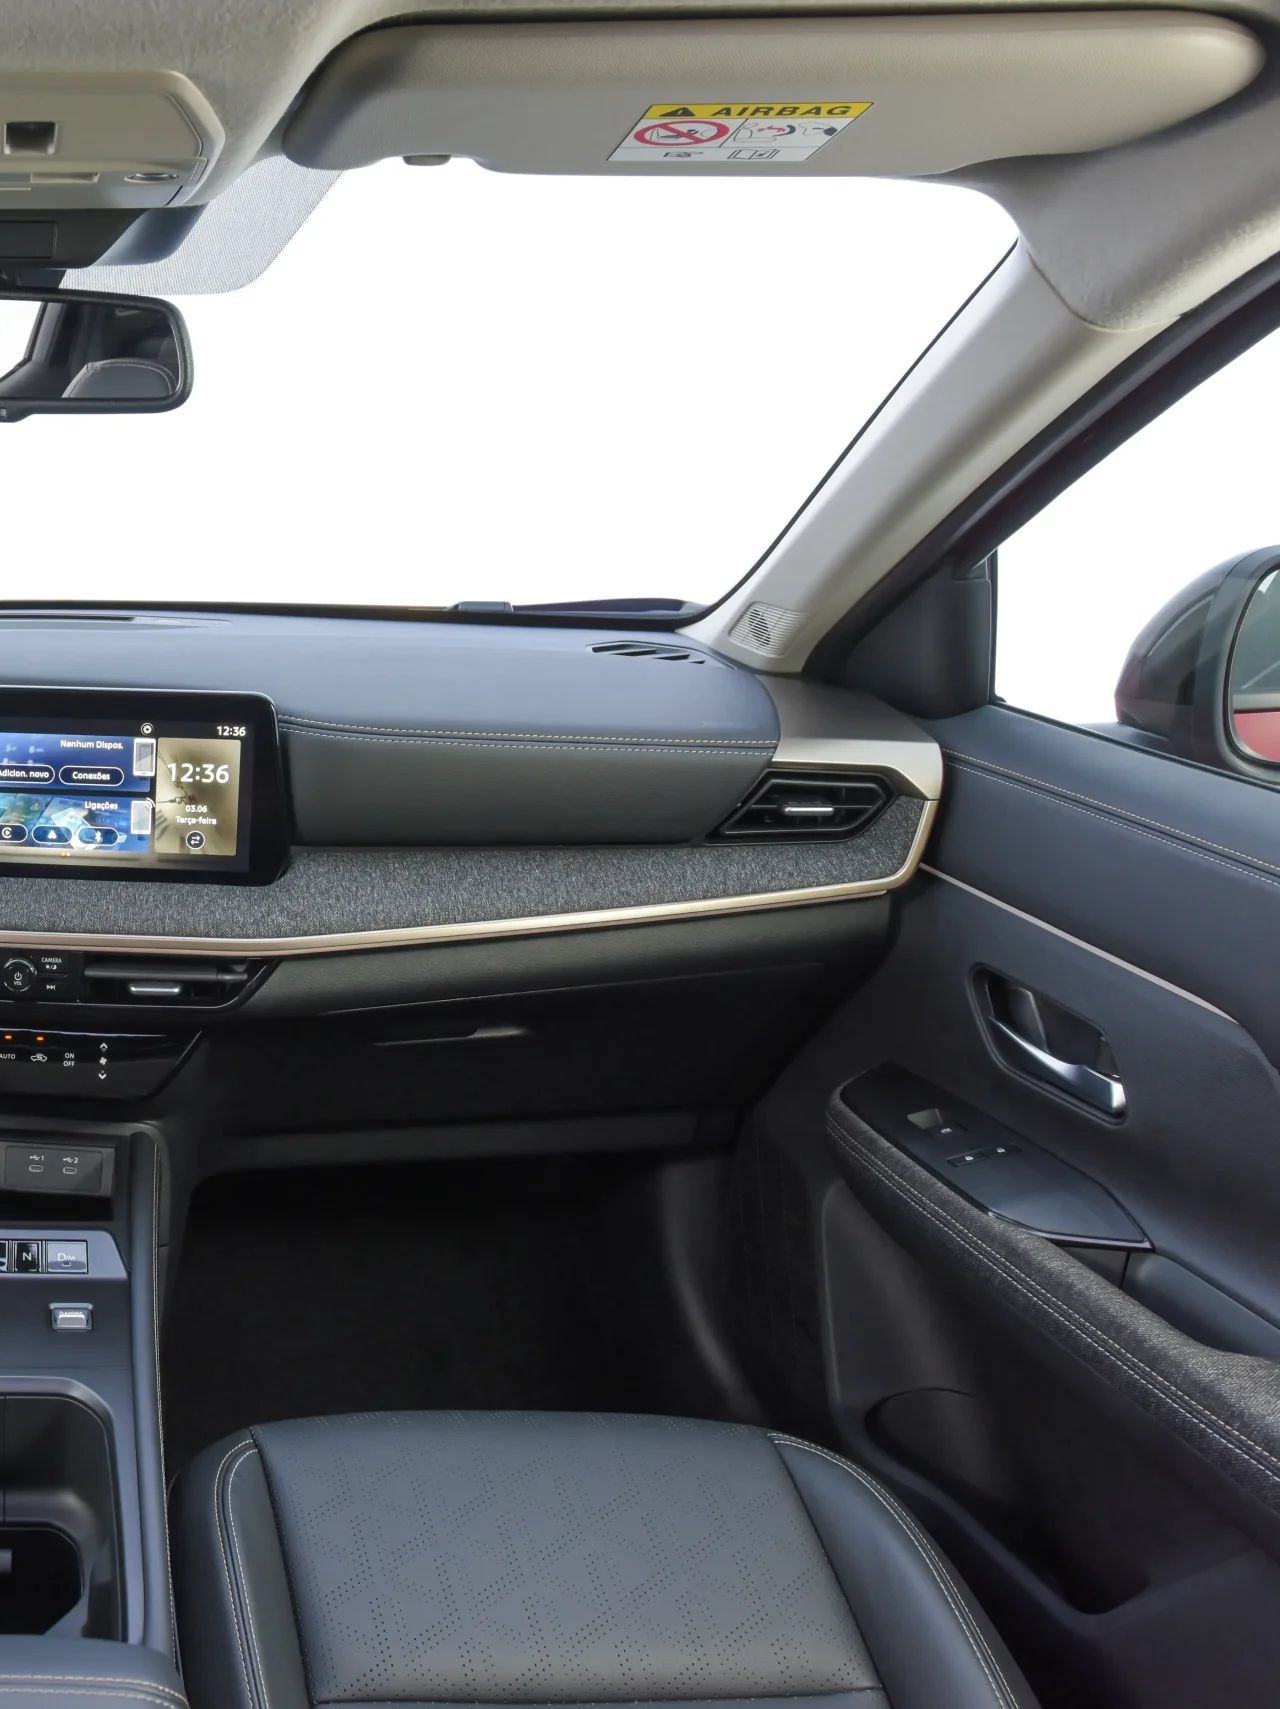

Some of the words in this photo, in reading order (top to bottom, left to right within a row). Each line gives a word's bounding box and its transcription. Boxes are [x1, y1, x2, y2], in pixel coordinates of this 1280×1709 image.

[709, 106, 852, 117] AIRBAG
[216, 726, 246, 737] 12:36
[60, 740, 94, 749] Nenhum
[95, 740, 124, 751] Dispos.
[29, 770, 50, 779] novo
[72, 771, 111, 781] Conexões
[167, 763, 230, 784] 12:36
[84, 801, 119, 812] Ligações
[185, 805, 208, 813] 03.06
[176, 816, 217, 825] Terça-feira
[22, 1252, 32, 1260] N
